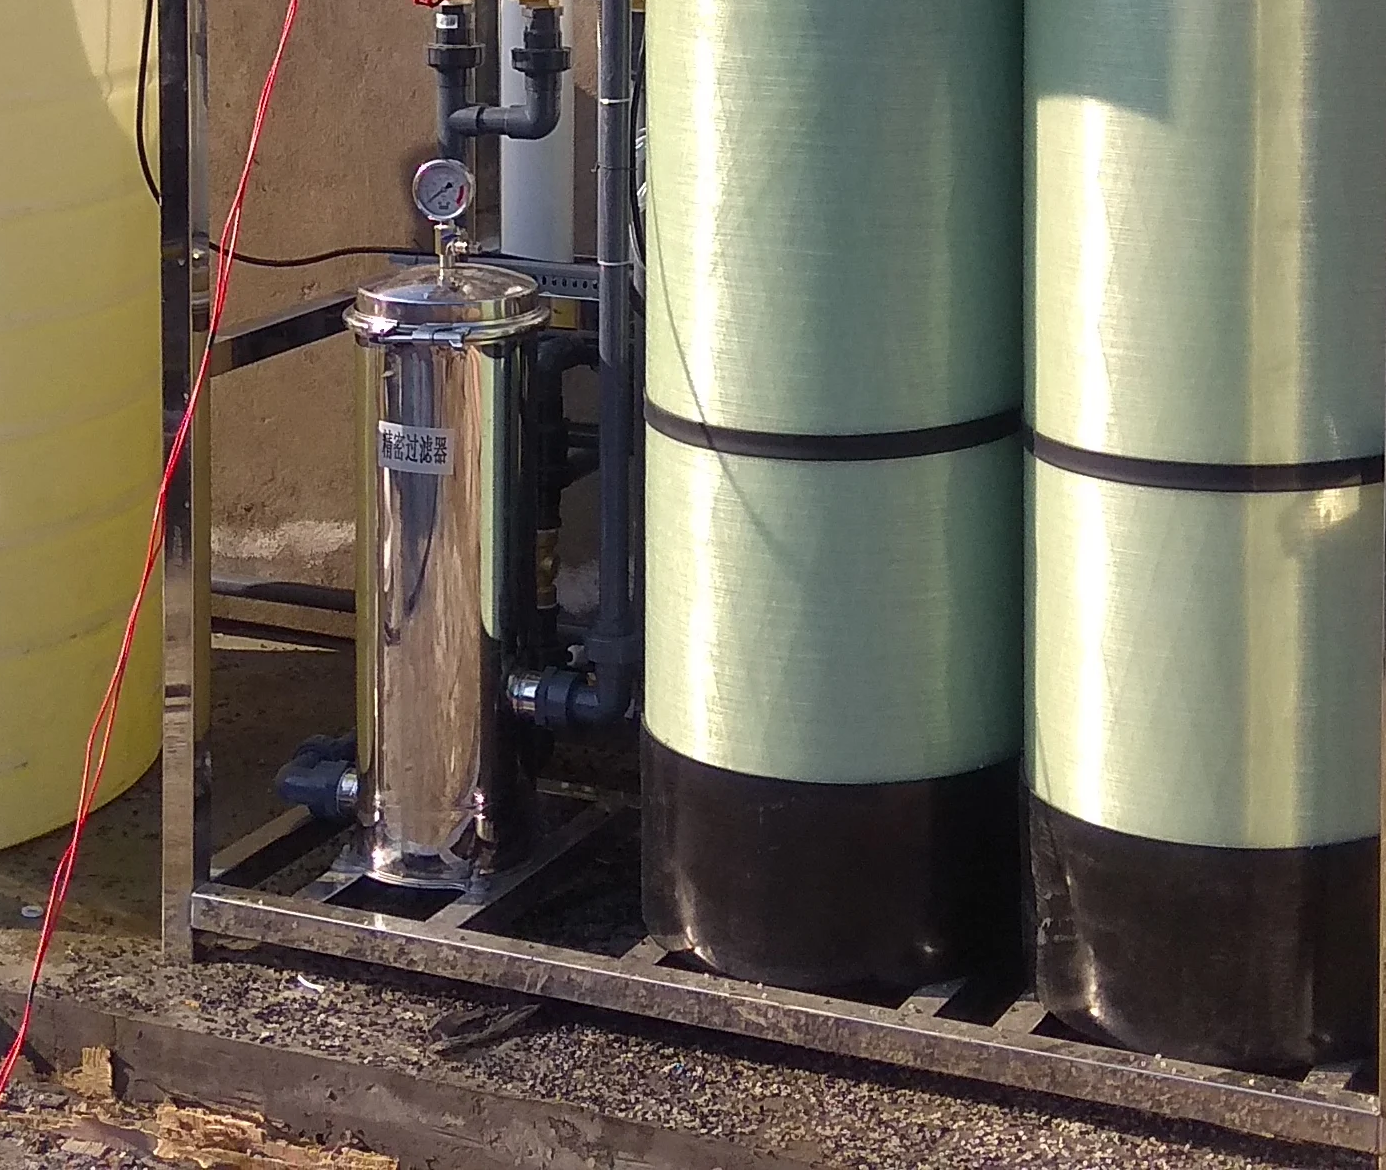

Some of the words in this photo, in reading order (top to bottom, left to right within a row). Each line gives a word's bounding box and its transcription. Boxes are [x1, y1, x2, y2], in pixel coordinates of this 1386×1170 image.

[382, 429, 447, 464] 精密过滤器
